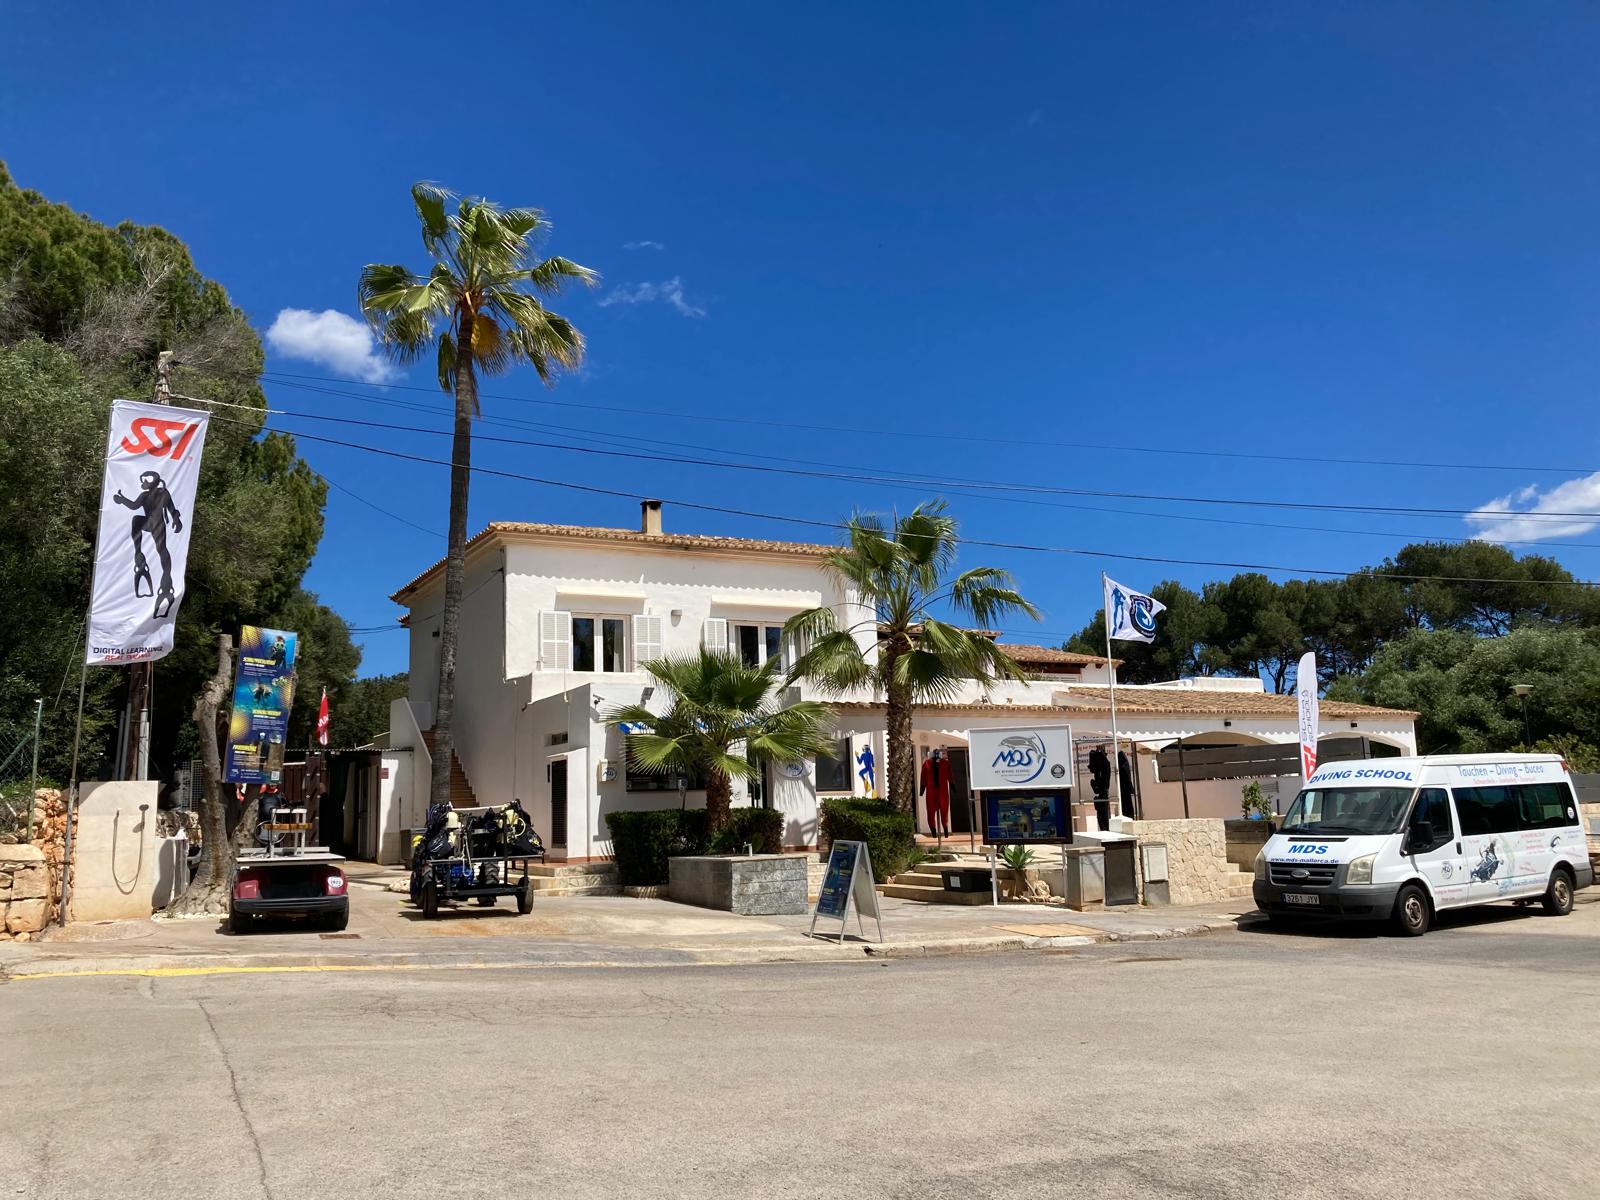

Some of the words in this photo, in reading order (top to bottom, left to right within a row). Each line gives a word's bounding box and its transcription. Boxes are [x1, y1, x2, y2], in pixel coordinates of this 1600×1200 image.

[121, 416, 200, 461] SSI
[93, 647, 125, 655] DIGITAL
[126, 646, 163, 655] LEARNING
[1309, 770, 1352, 784] DIVING
[1354, 769, 1413, 781] SCHOOL
[1496, 763, 1519, 778] Diving
[1288, 845, 1329, 854] MDS
